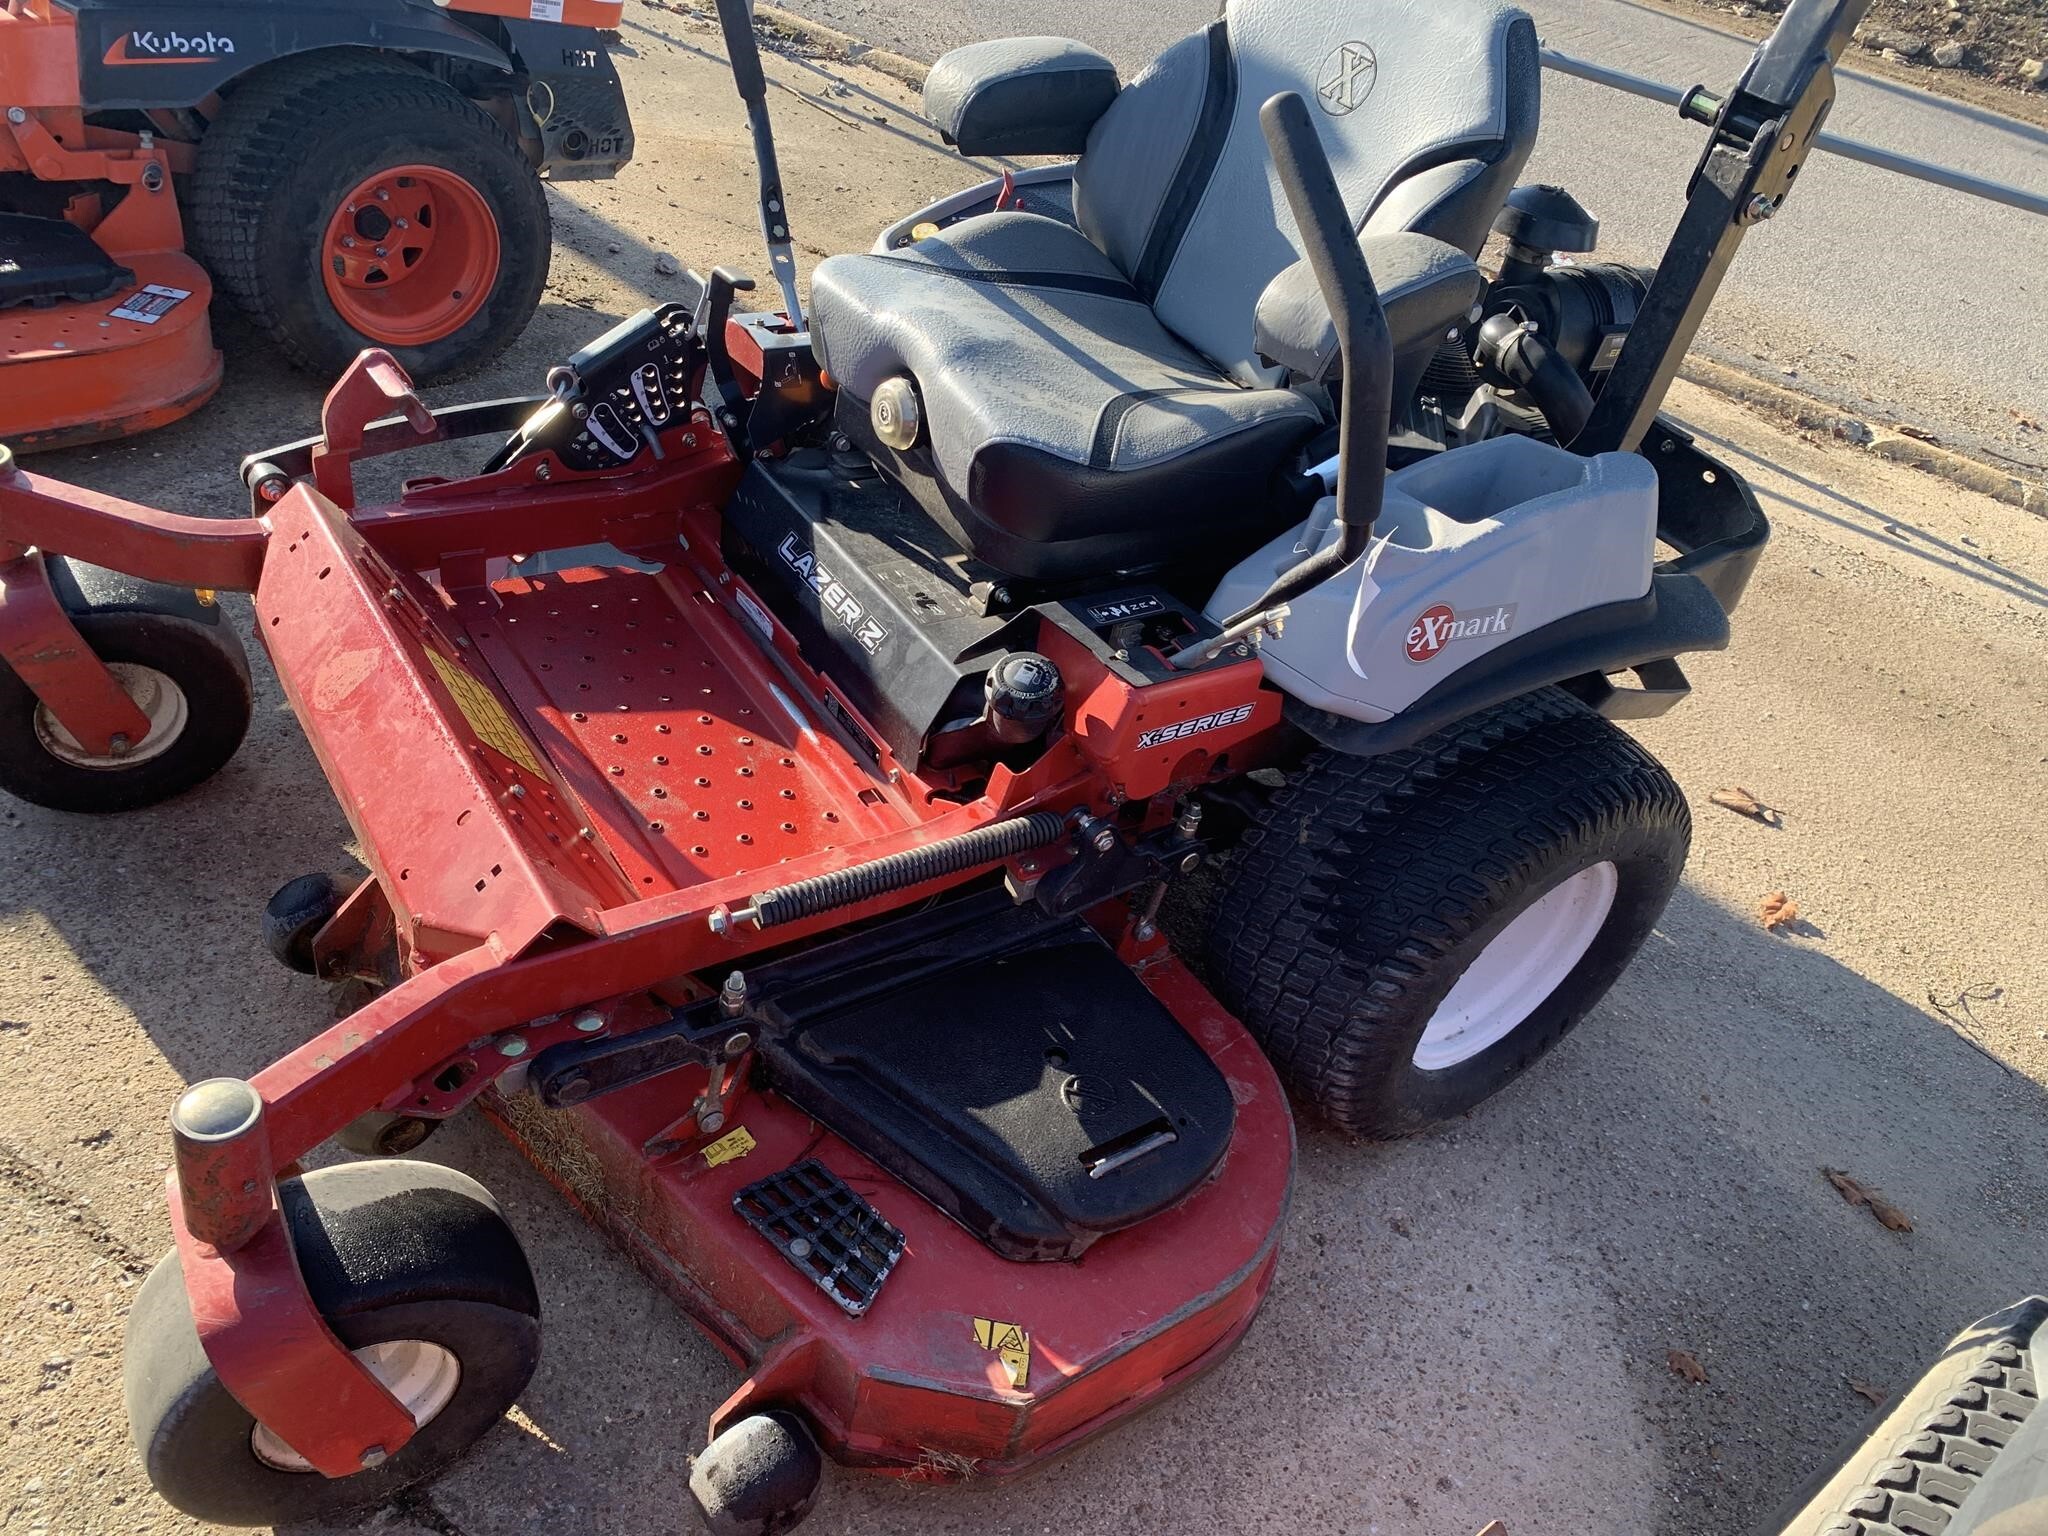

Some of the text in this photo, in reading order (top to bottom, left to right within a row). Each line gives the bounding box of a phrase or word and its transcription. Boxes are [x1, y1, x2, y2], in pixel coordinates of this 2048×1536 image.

[133, 31, 235, 53] Kubota
[562, 49, 597, 68] HOT
[588, 138, 624, 154] HOT
[779, 532, 864, 631] LAZER
[854, 616, 888, 654] Z
[1406, 607, 1513, 653] eXmark
[1136, 702, 1256, 750] X-SERIES
